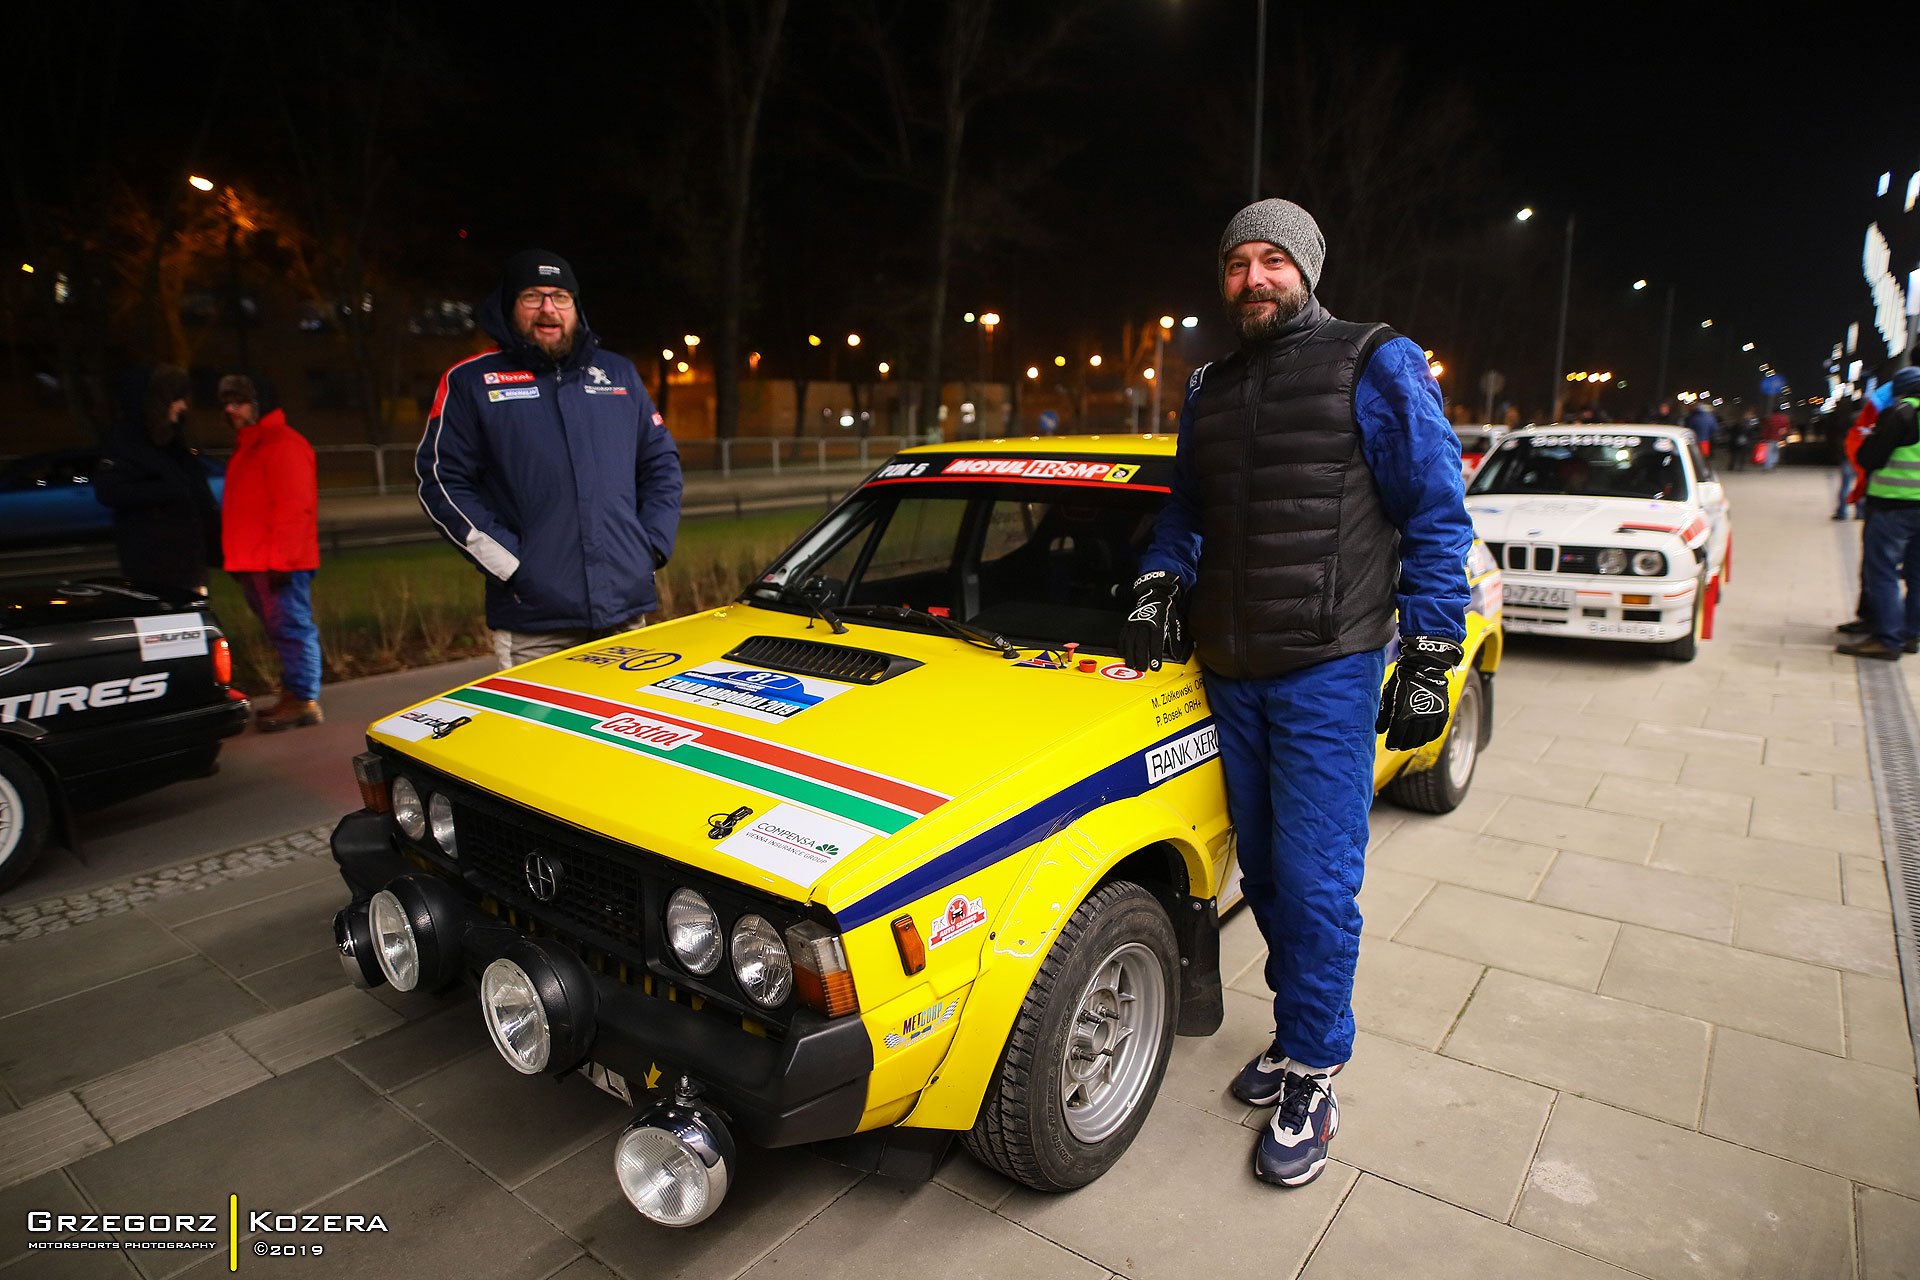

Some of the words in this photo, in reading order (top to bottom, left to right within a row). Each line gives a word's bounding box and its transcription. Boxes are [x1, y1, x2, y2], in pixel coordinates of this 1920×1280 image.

[1531, 435, 1641, 448] Backstage
[910, 463, 930, 477] 5
[949, 460, 1028, 474] MOTUL
[746, 672, 788, 684] 87
[1114, 668, 1130, 677] E
[0, 672, 169, 723] TIRES
[757, 700, 800, 716] 2019
[1156, 716, 1163, 727] P.
[1162, 707, 1183, 724] Bosek
[602, 716, 690, 747] Castrol
[1151, 739, 1193, 777] RANK
[757, 822, 816, 848] COMPENSA
[745, 831, 768, 844] VIENNA
[768, 838, 804, 857] INSURANCE
[804, 852, 828, 865] GROUP
